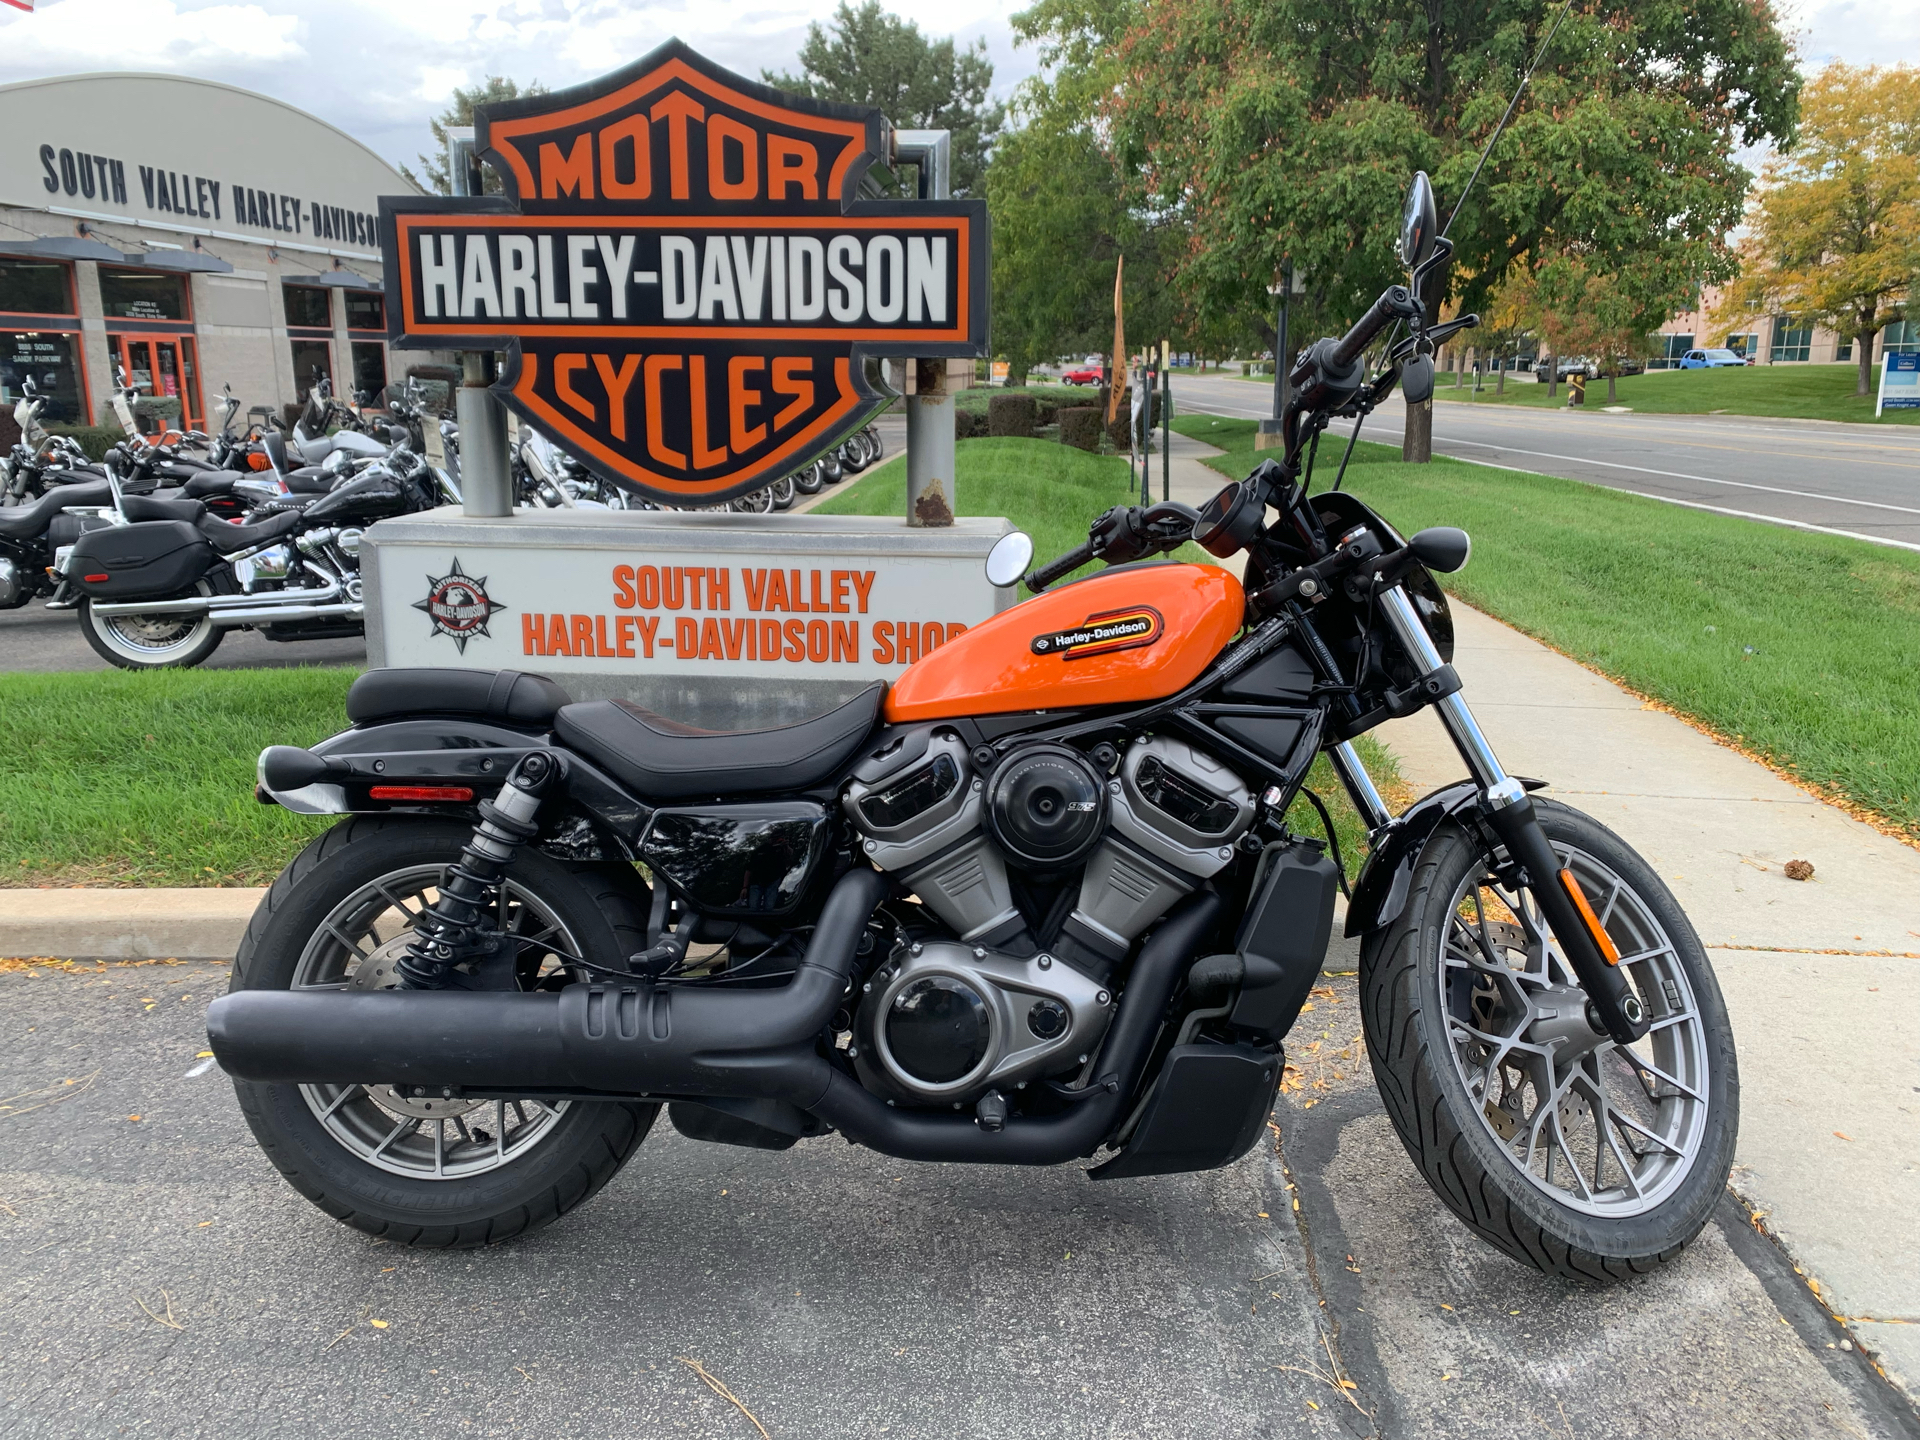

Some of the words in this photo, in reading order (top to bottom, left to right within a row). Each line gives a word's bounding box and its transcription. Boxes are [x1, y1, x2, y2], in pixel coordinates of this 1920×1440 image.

[540, 91, 819, 200] MOTOR
[39, 144, 128, 205] SOUTH
[138, 165, 221, 220] VALLEY
[419, 234, 948, 323] HARLEY-DAVIDSON
[33, 343, 54, 351] SOUTH
[34, 355, 61, 363] PARKWAY
[554, 354, 814, 470] CYCLES
[432, 576, 484, 596] AUTHORIZED
[613, 564, 731, 611] SOUTH
[742, 568, 876, 614] VALLEY
[432, 601, 487, 620] HARLEY-DAVIDSON
[436, 621, 484, 638] RENTALS
[521, 613, 860, 664] HARLEY-DAVIDSON
[1055, 621, 1147, 647] Harley-Davidson
[1010, 761, 1064, 785] REVOLUTION
[1067, 769, 1086, 787] MAX
[1066, 801, 1097, 812] 975
